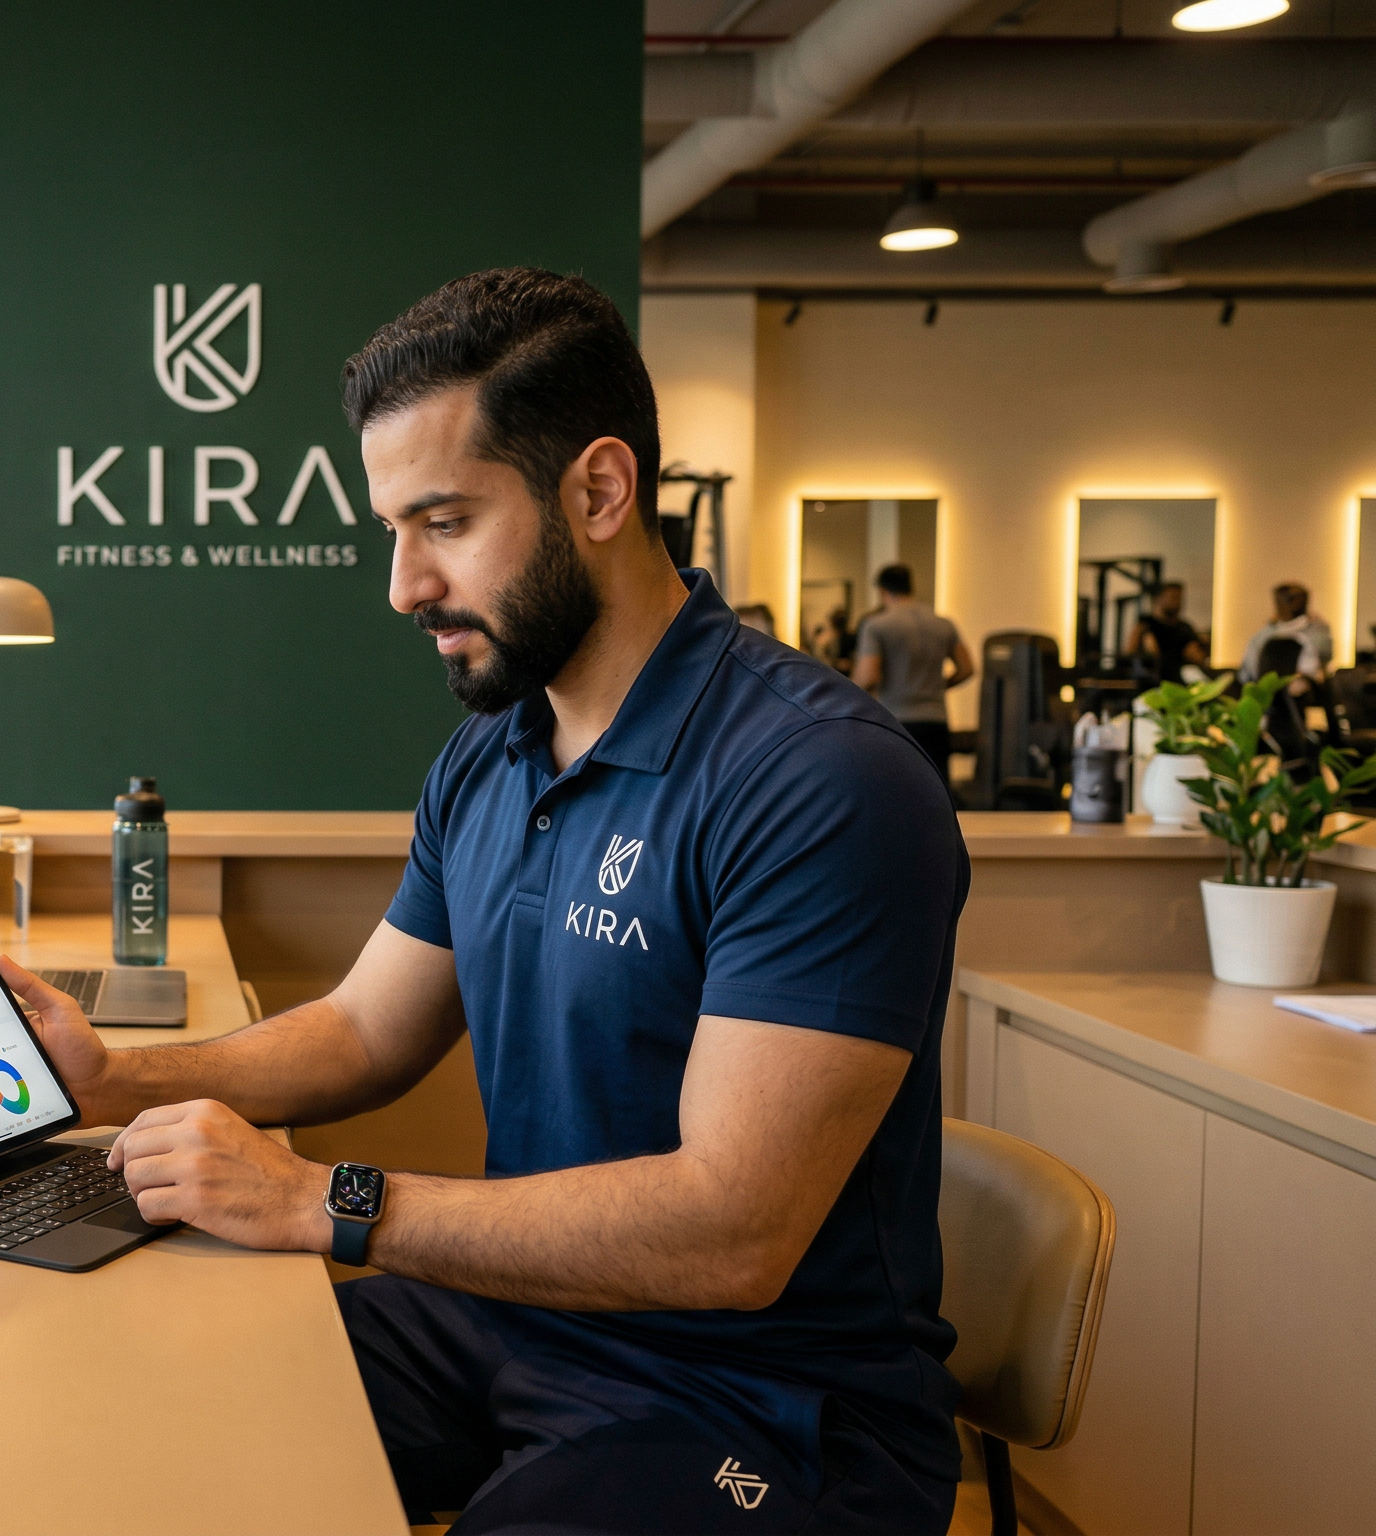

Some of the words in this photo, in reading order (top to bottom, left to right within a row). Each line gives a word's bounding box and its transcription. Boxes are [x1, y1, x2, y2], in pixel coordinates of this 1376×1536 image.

[57, 446, 358, 526] KIRA
[57, 545, 172, 567] FITNESS
[181, 545, 199, 567] &
[208, 545, 358, 567] WELLNESS
[132, 858, 154, 934] KIRA
[565, 901, 649, 951] KIRA
